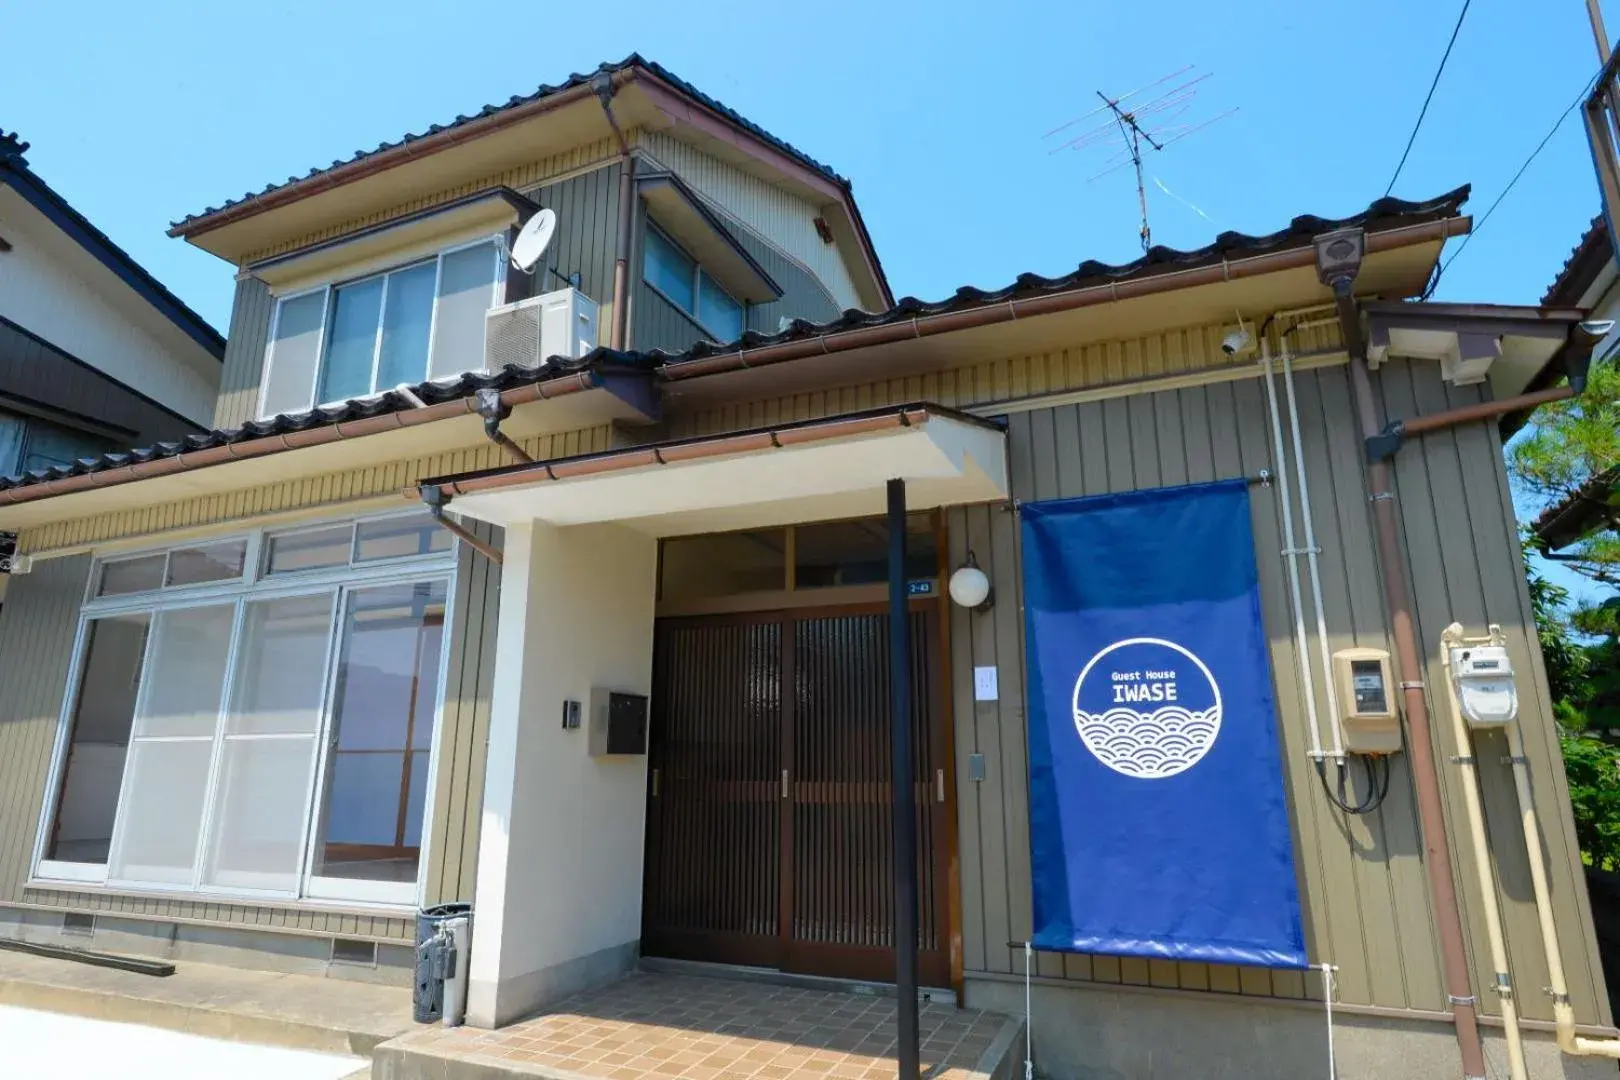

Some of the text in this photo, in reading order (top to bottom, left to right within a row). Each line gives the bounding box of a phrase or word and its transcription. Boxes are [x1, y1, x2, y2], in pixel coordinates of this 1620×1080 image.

[1111, 670, 1176, 681] Guest House
[1112, 682, 1177, 703] IWASE
